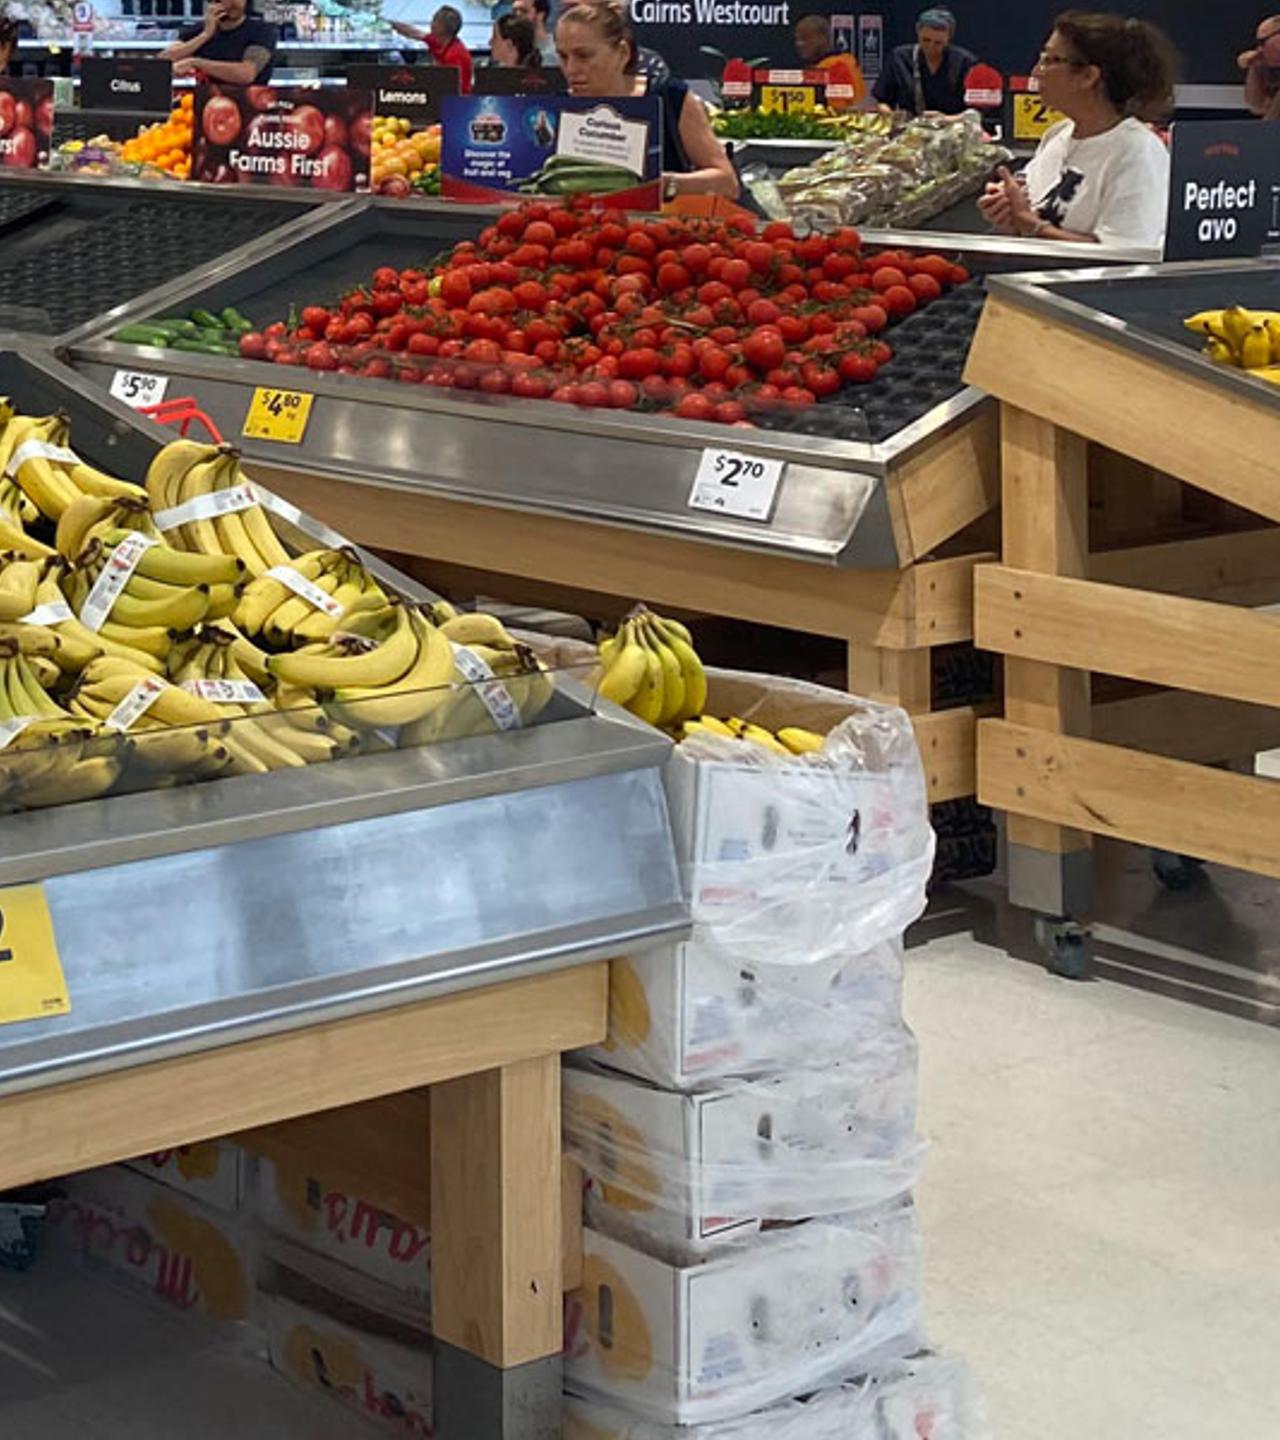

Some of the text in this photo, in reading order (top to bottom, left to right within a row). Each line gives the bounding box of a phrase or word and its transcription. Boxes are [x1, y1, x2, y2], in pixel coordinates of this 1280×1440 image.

[110, 78, 141, 93] Citrus
[379, 89, 428, 105] Lemons
[247, 127, 311, 150] Aussie
[229, 150, 330, 177] Farms First
[1184, 180, 1256, 210] Perfect
[1198, 217, 1237, 241] avo
